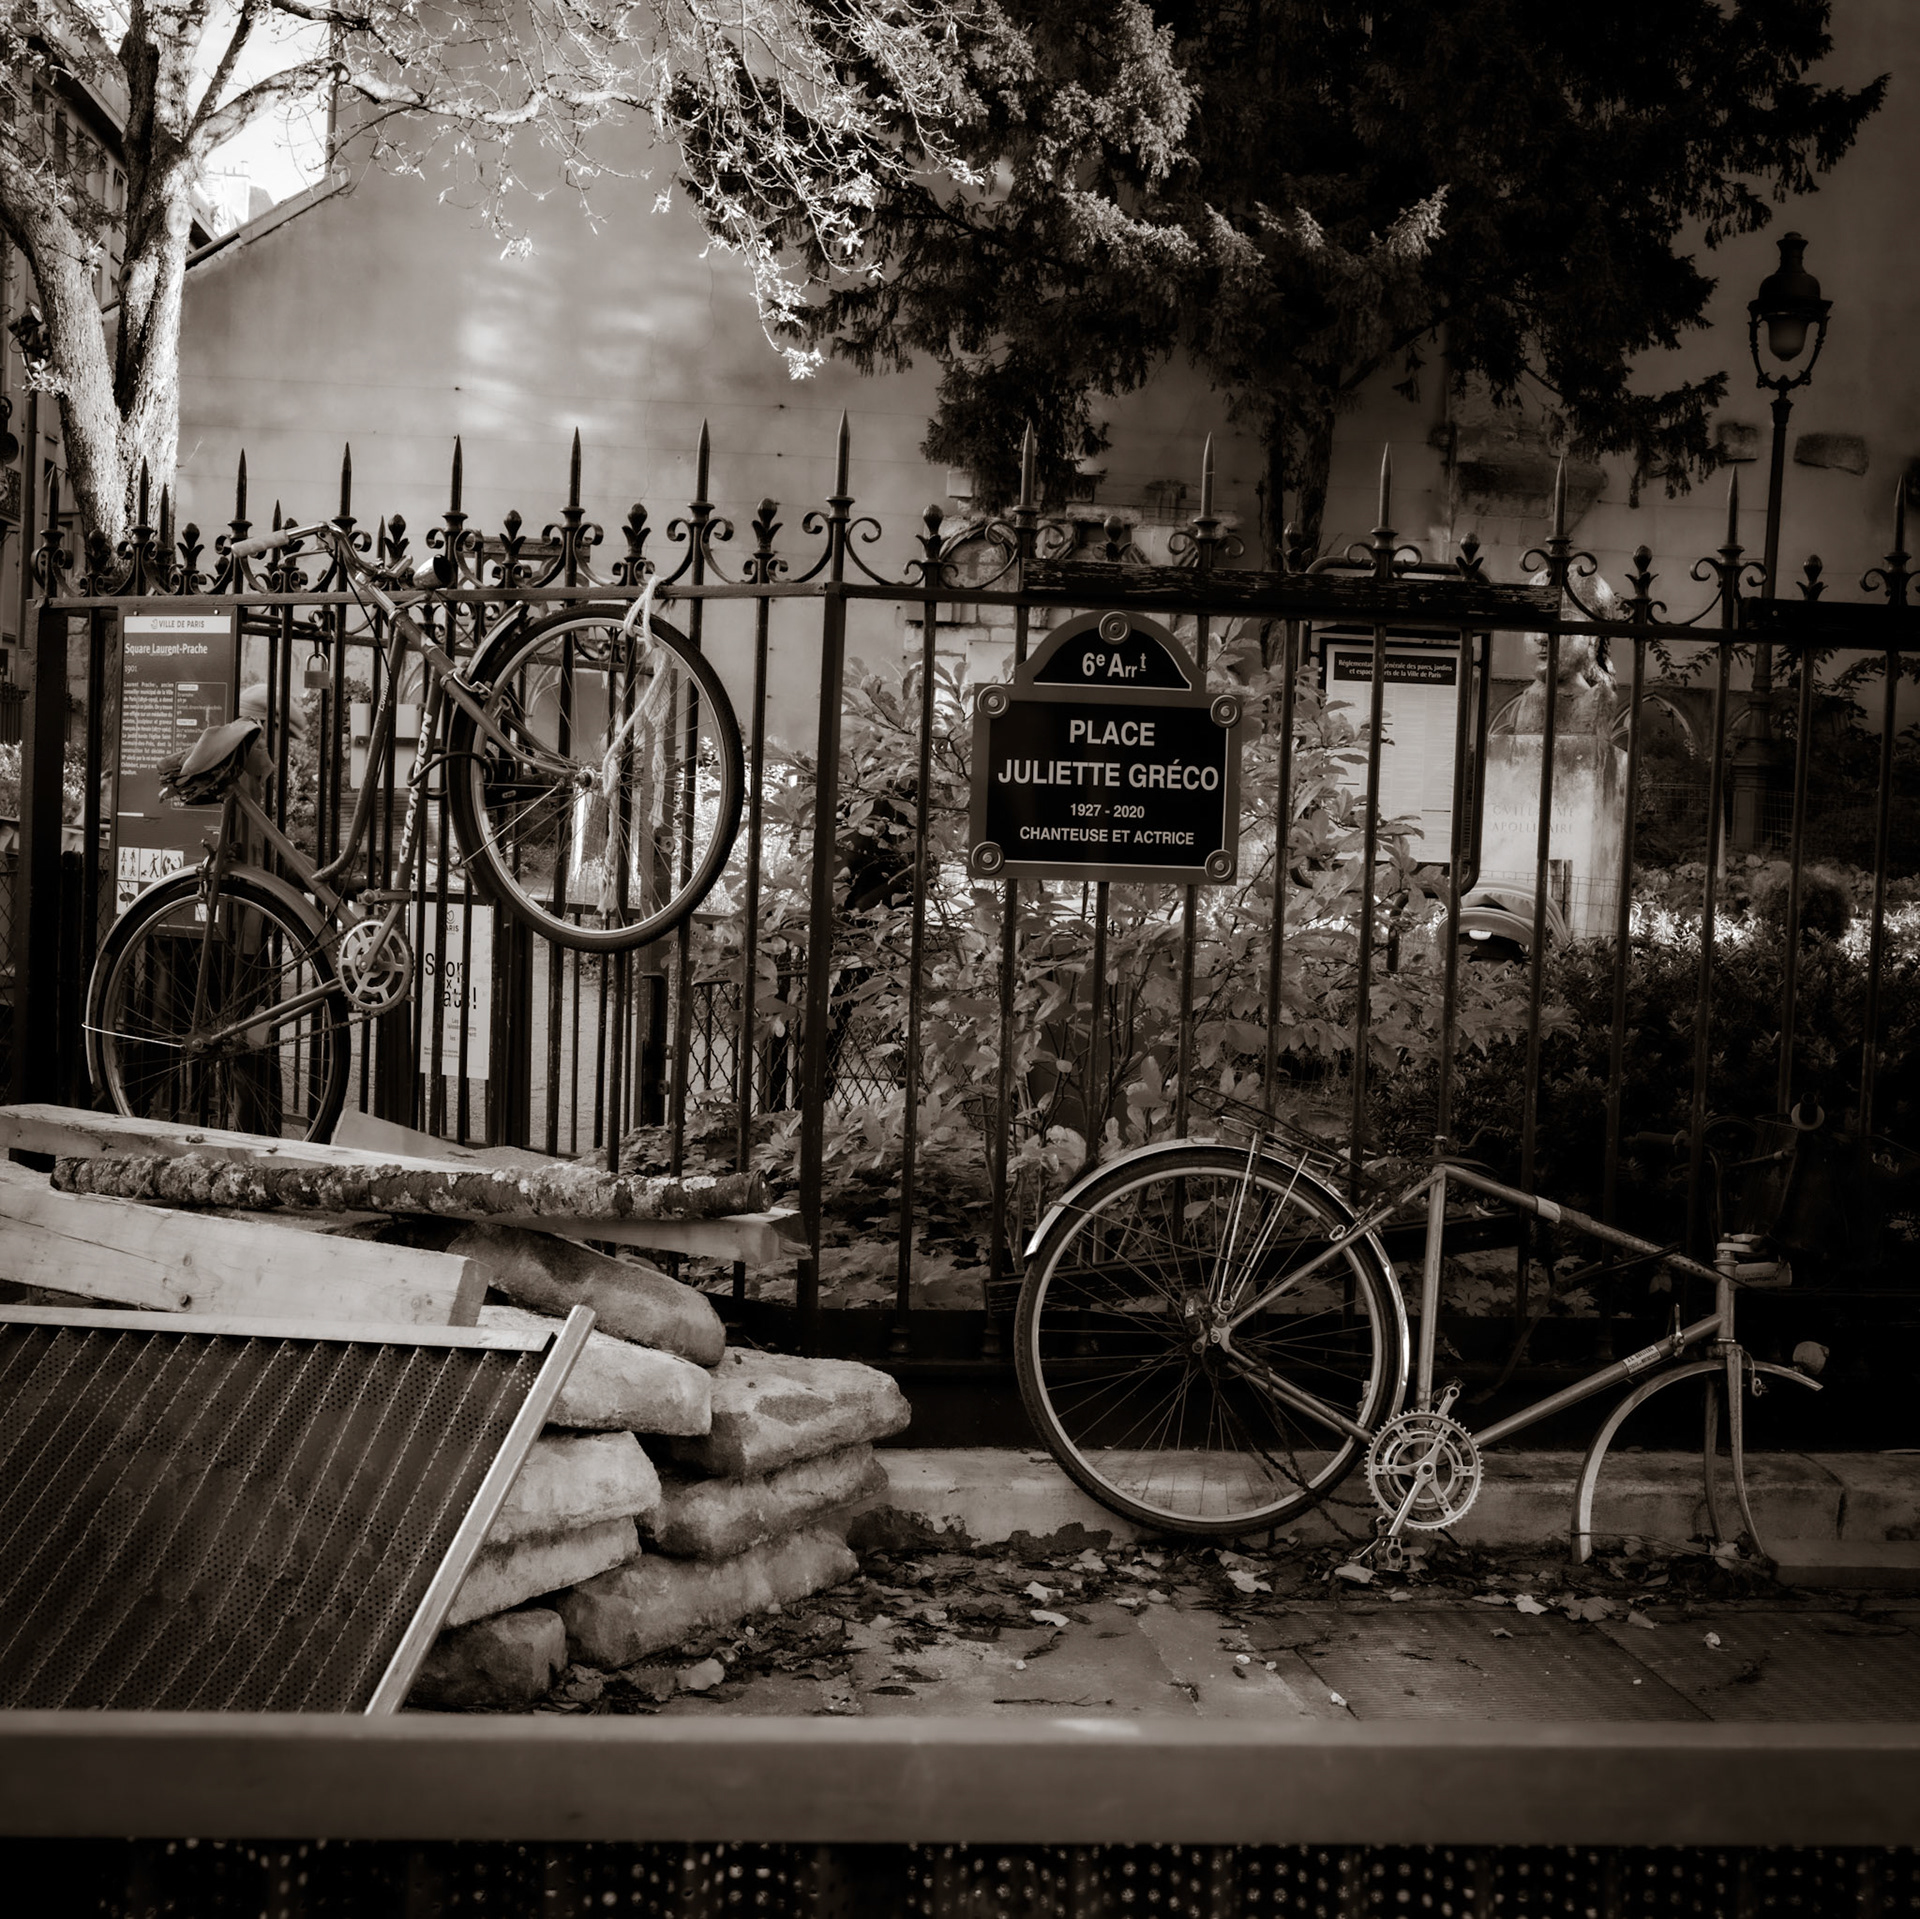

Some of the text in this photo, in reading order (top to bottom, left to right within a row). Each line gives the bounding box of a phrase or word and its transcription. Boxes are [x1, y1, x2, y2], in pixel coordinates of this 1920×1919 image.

[159, 620, 205, 628] VILLE DE PARIS
[125, 643, 208, 656] Square Laurent-Prache
[1069, 719, 1155, 746] PLACE
[998, 759, 1219, 791] JULIETTE GRÉCO
[400, 712, 433, 864] CHAMPION
[1070, 803, 1101, 816] 1927
[1113, 805, 1145, 818] 2020
[1020, 826, 1194, 845] CHANTEUSE ET ACTRICE
